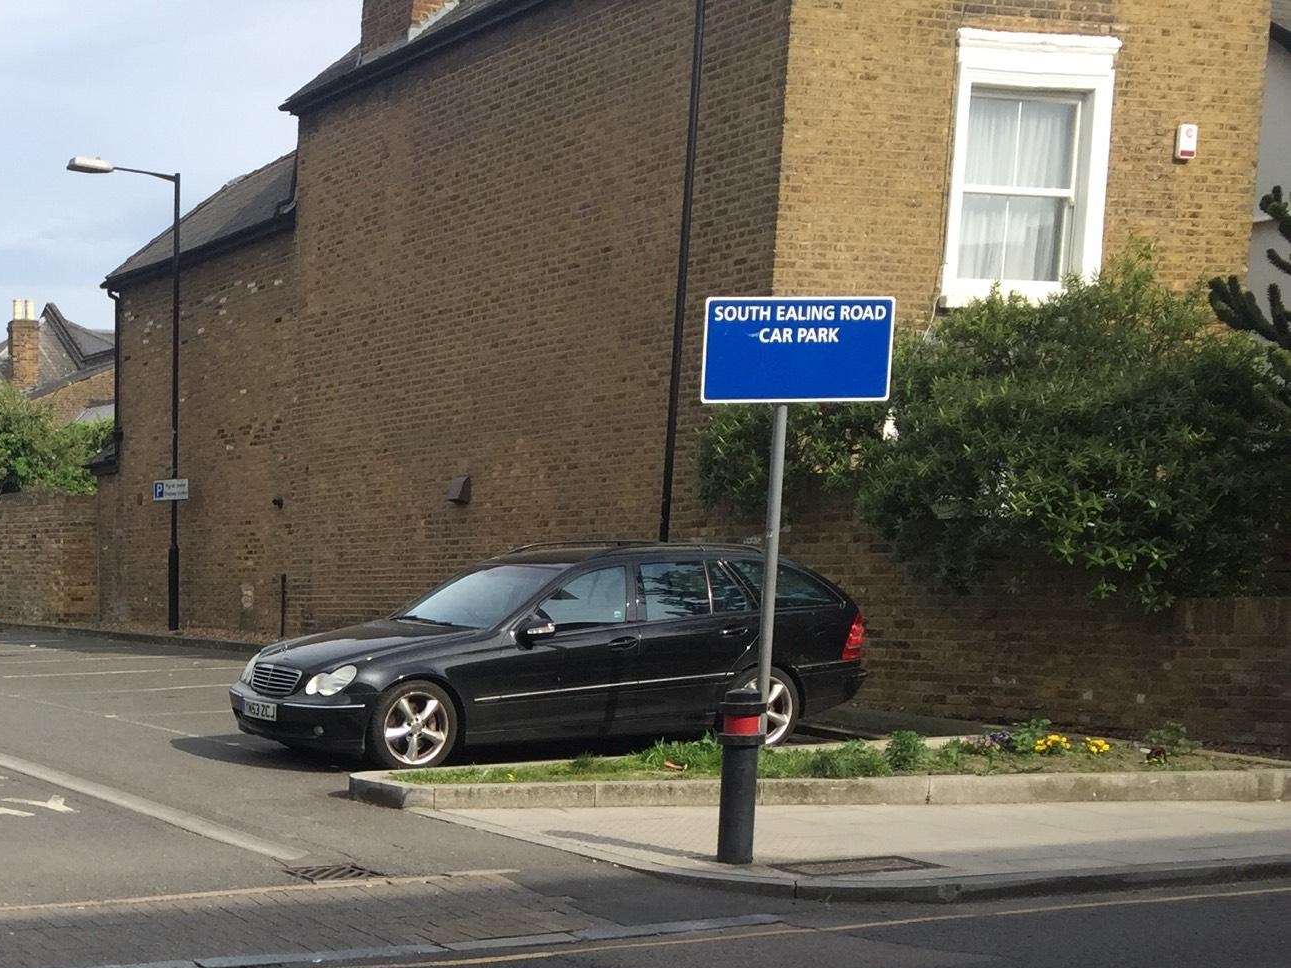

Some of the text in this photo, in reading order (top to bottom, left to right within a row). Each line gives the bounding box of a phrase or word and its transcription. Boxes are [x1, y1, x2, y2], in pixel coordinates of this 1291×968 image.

[714, 305, 887, 322] SOUTH EALING ROAD
[759, 327, 840, 343] CAR PARK
[156, 484, 163, 497] P
